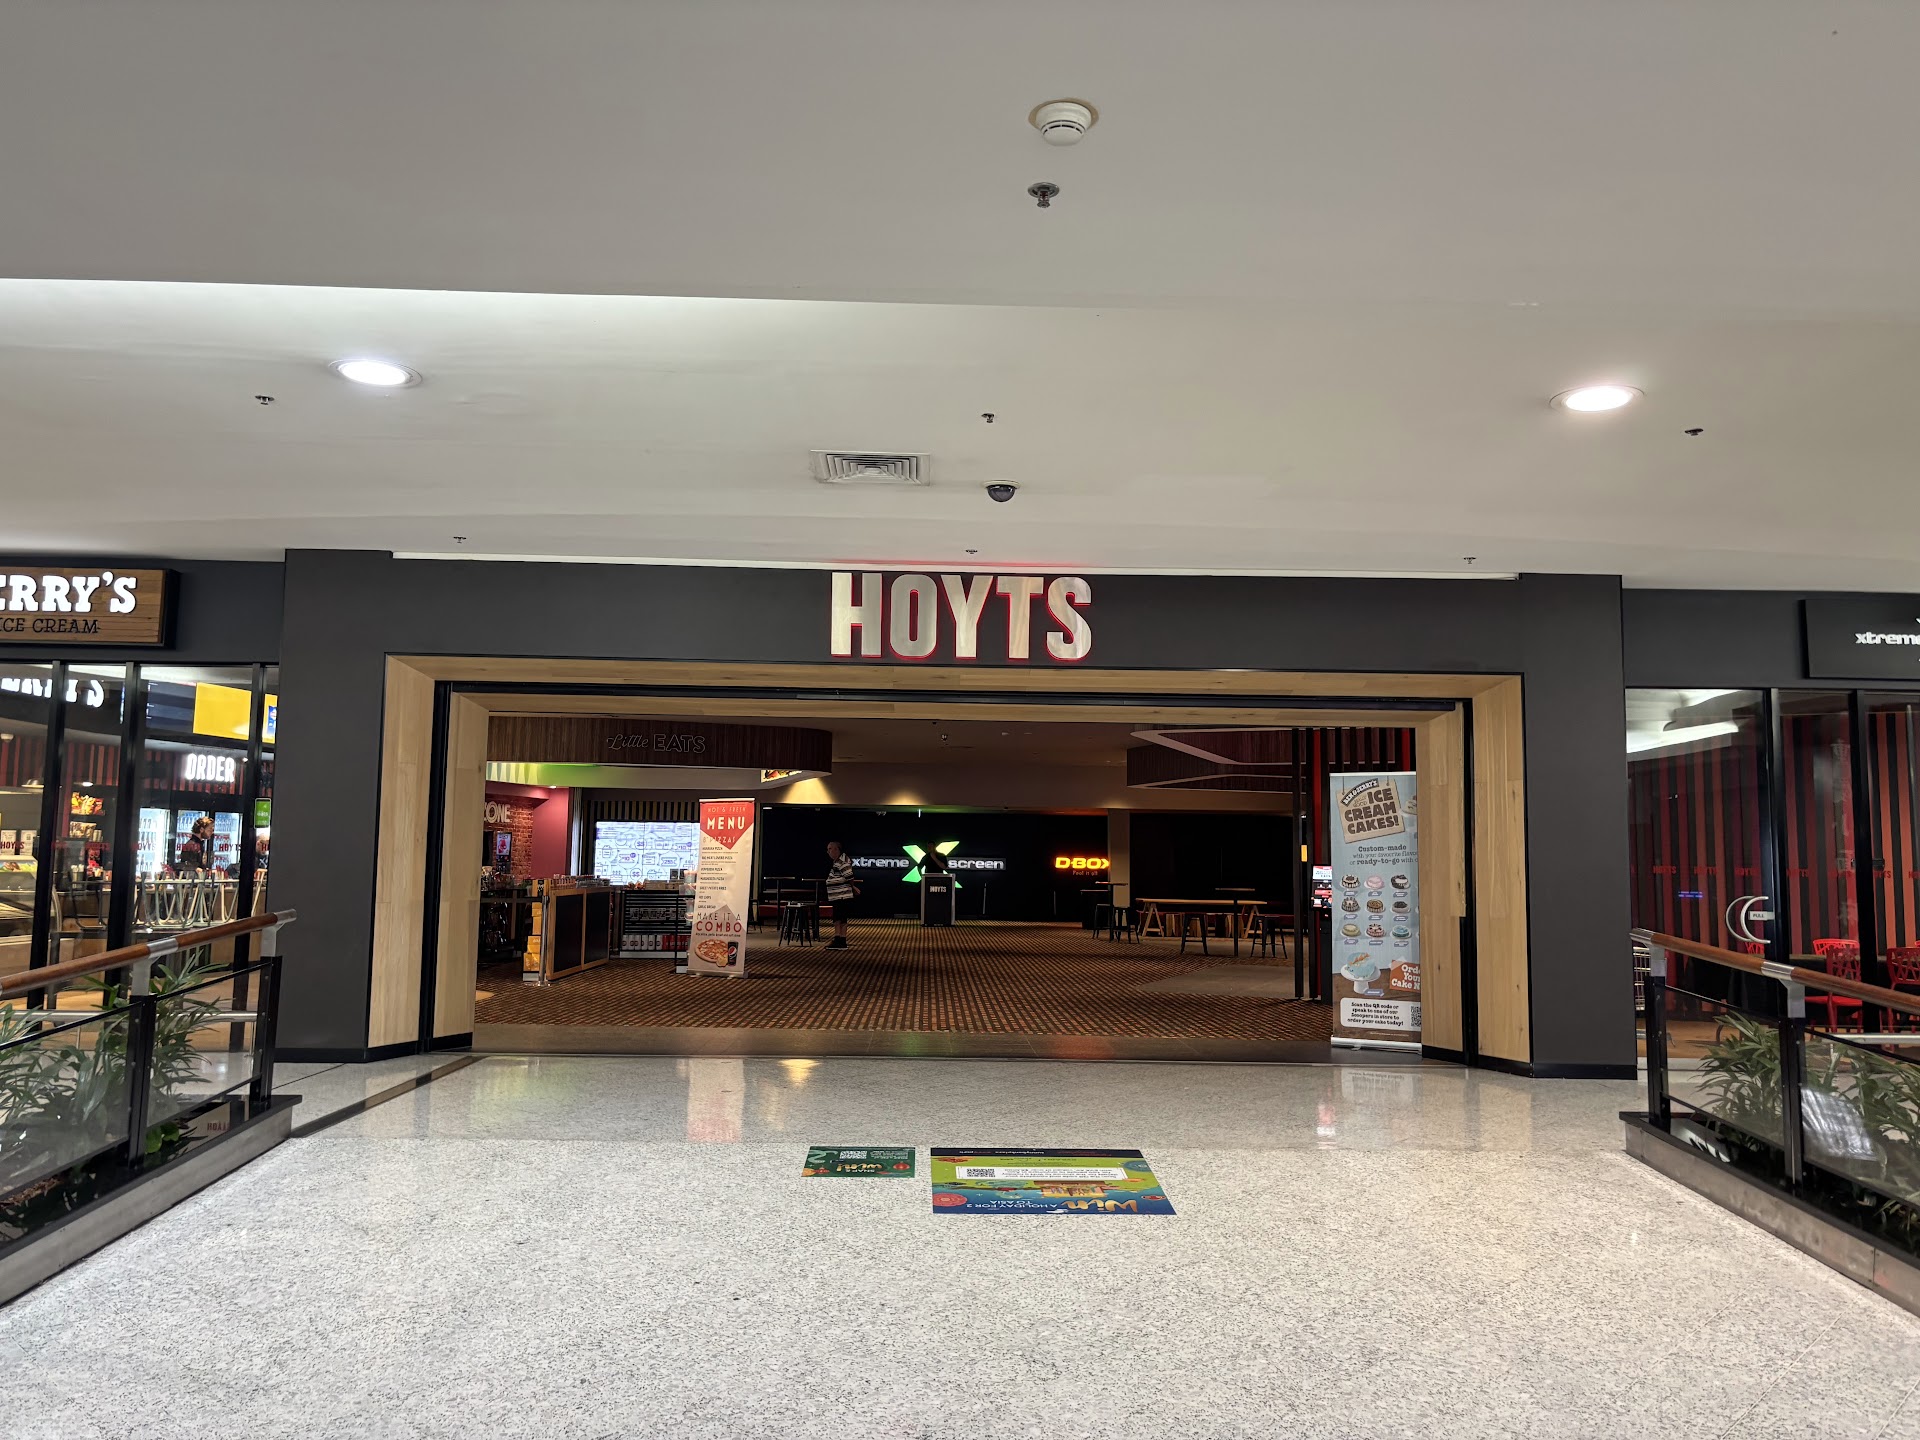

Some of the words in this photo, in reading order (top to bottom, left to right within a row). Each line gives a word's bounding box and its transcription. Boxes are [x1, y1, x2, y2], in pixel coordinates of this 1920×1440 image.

[0, 571, 137, 613] RRY'S
[831, 572, 1092, 660] HOYTS
[33, 618, 98, 633] CREAM
[606, 733, 649, 751] Little
[653, 733, 706, 754] EATS
[185, 753, 235, 783] ORDER
[1366, 788, 1394, 804] ICE
[1344, 801, 1397, 822] CREAM
[706, 816, 745, 830] MENU
[1347, 815, 1400, 834] CAKES!
[1358, 844, 1407, 853] Custom-made
[851, 857, 910, 868] xtreme
[947, 858, 1004, 869] screen
[1356, 858, 1400, 866] ready-to-go
[929, 885, 947, 893] HOYTS
[696, 912, 718, 921] MAKE
[723, 912, 731, 921] IT
[735, 913, 741, 921] A
[696, 920, 742, 933] COMBO
[1391, 978, 1412, 989] Cake
[836, 1163, 883, 1172] win!
[1060, 1199, 1139, 1214] Win
